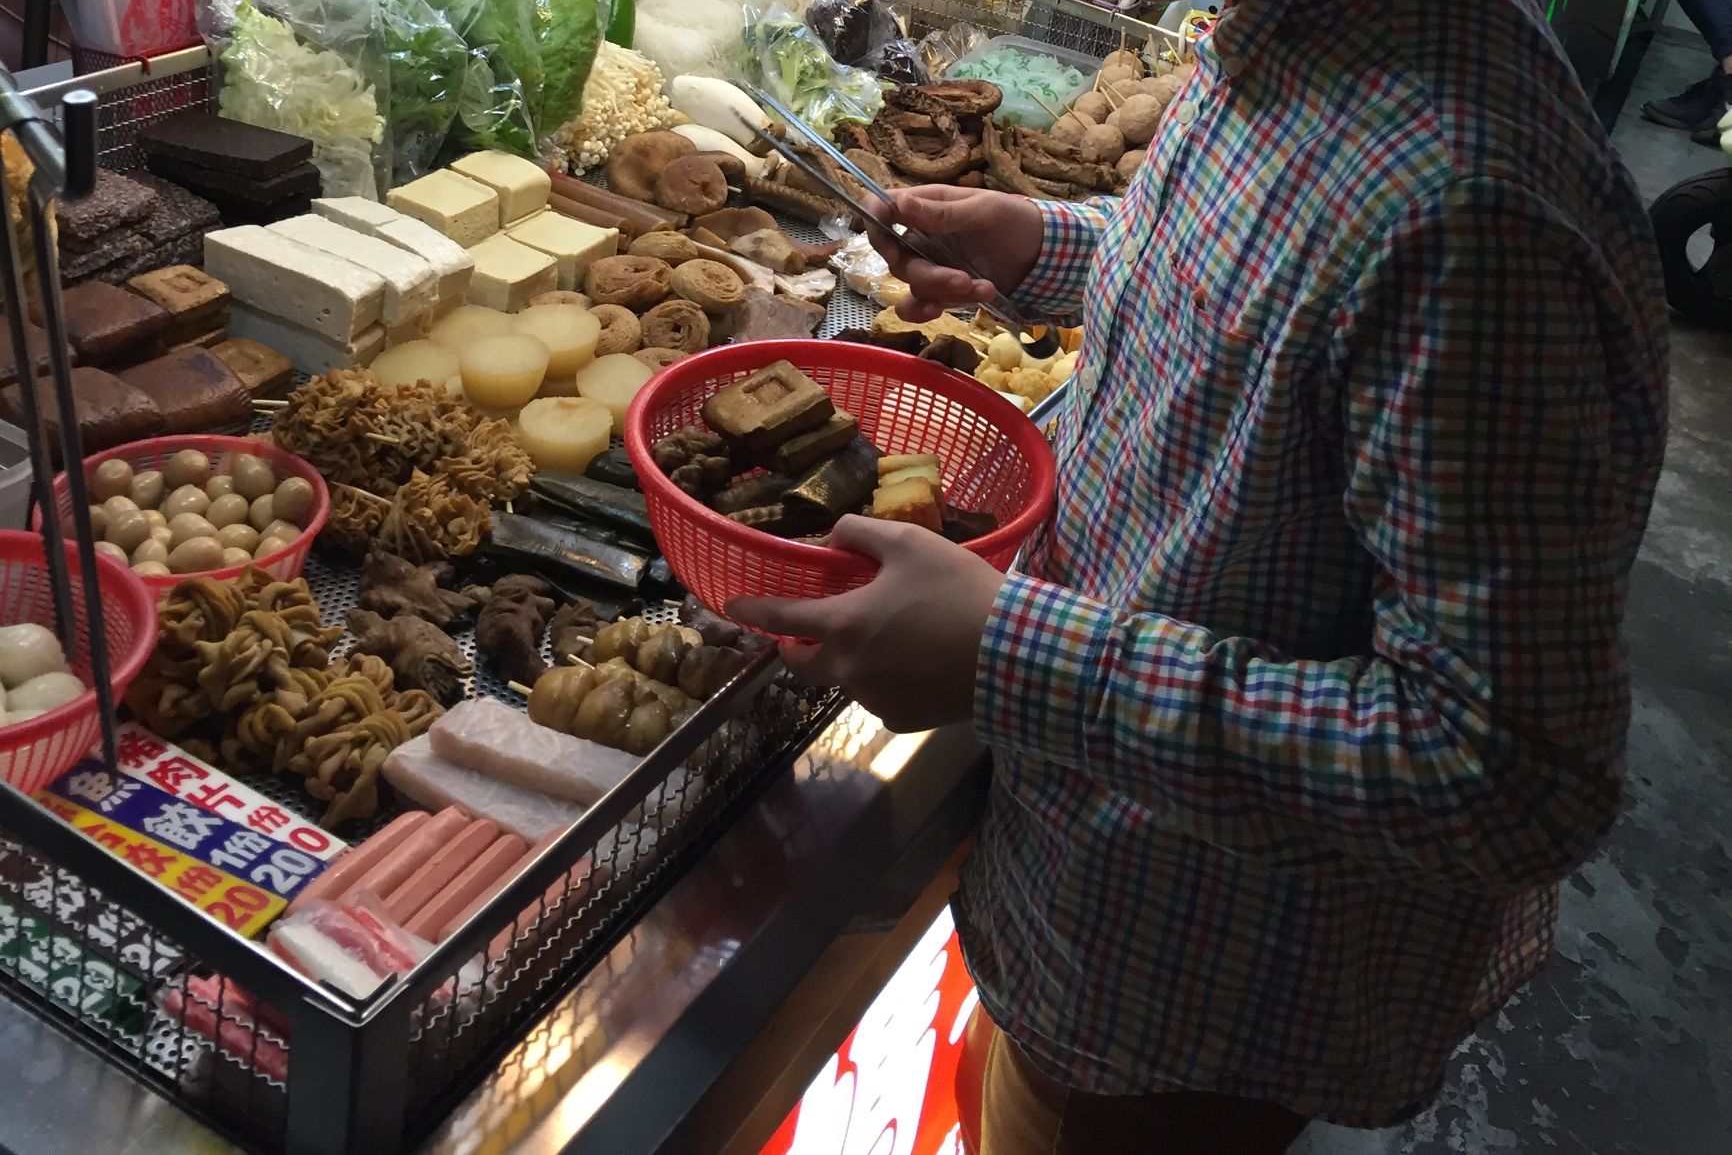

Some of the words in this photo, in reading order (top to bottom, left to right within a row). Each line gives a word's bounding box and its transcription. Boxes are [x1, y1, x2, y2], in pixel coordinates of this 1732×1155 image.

[247, 805, 290, 835] 份
[209, 831, 273, 869] 1份
[250, 849, 317, 894] 20
[205, 885, 270, 930] 20
